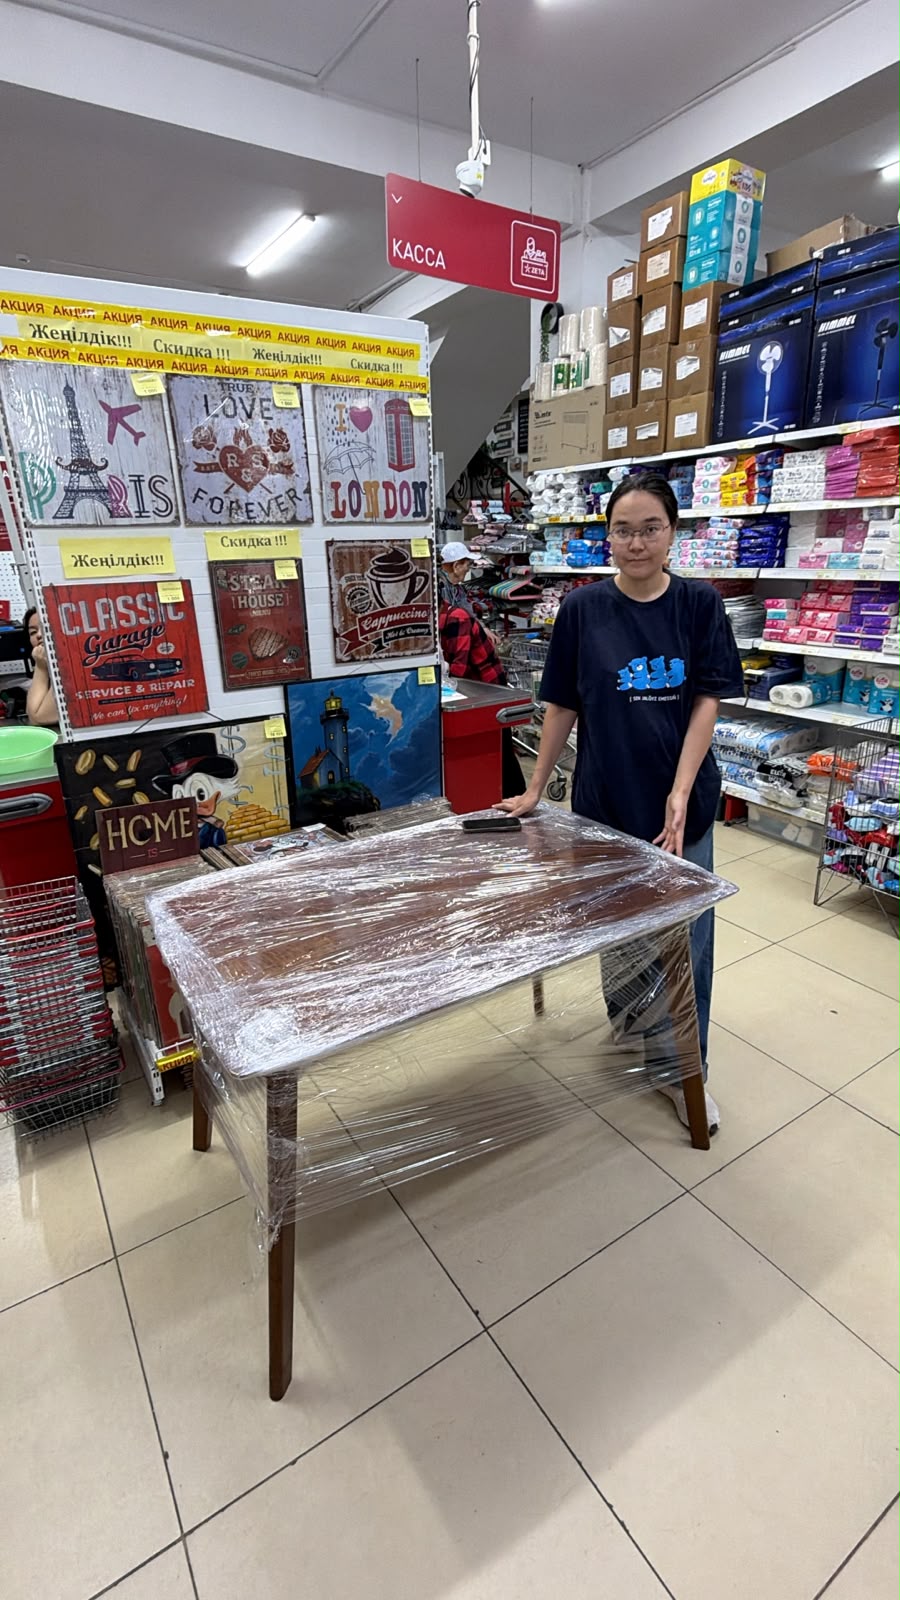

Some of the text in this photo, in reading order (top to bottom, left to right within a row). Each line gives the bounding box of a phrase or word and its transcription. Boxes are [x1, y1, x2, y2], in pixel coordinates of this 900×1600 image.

[392, 238, 446, 269] КАССА
[531, 268, 545, 276] ZETA
[1, 299, 45, 314] АКЦИЯ
[53, 305, 95, 319] АКЦИЯ
[103, 311, 143, 324] АКЦИЯ
[150, 316, 188, 330] АКЦИЯ
[238, 327, 272, 339] АКЦИЯ
[278, 332, 310, 344] АКЦИЯ
[315, 337, 346, 349] АКЦИЯ
[352, 342, 381, 354] АКЦИЯ
[386, 346, 415, 358] АКЦИЯ
[818, 314, 857, 333] HIMMEL
[29, 323, 133, 349] Жеңілдік!!!
[153, 338, 212, 359] Скидка
[252, 347, 322, 366] Жеңілдік!!!
[350, 358, 390, 373] Скидка
[27, 346, 70, 360] АКЦИЯ
[78, 352, 119, 366] АКЦИЯ
[126, 357, 164, 369] АКЦИЯ
[171, 361, 208, 373] АКЦИЯ
[214, 364, 249, 376] АКЦИЯ
[255, 367, 288, 379] АКЦИЯ
[294, 370, 325, 381] АКЦИЯ
[330, 373, 360, 384] АКЦИЯ
[365, 376, 394, 388] АКЦИЯ
[399, 380, 427, 391] АКЦИЯ
[217, 382, 254, 394] TRUE
[203, 393, 273, 420] LOVE
[335, 403, 347, 432] I
[192, 488, 302, 520] FOREVER
[331, 480, 427, 519] LONDON
[220, 535, 272, 548] Скидка
[71, 554, 164, 569] Жеңілдік!!!
[58, 591, 184, 636] CLASSIC
[238, 593, 284, 608] HOUSE
[361, 607, 428, 630] Cappuccino
[83, 624, 165, 668] Garage
[75, 685, 131, 700] SERVICE
[136, 684, 145, 693] &
[150, 679, 195, 692] REPAIR
[107, 709, 125, 717] can
[143, 694, 187, 712] anything!
[105, 807, 193, 851] HOME
